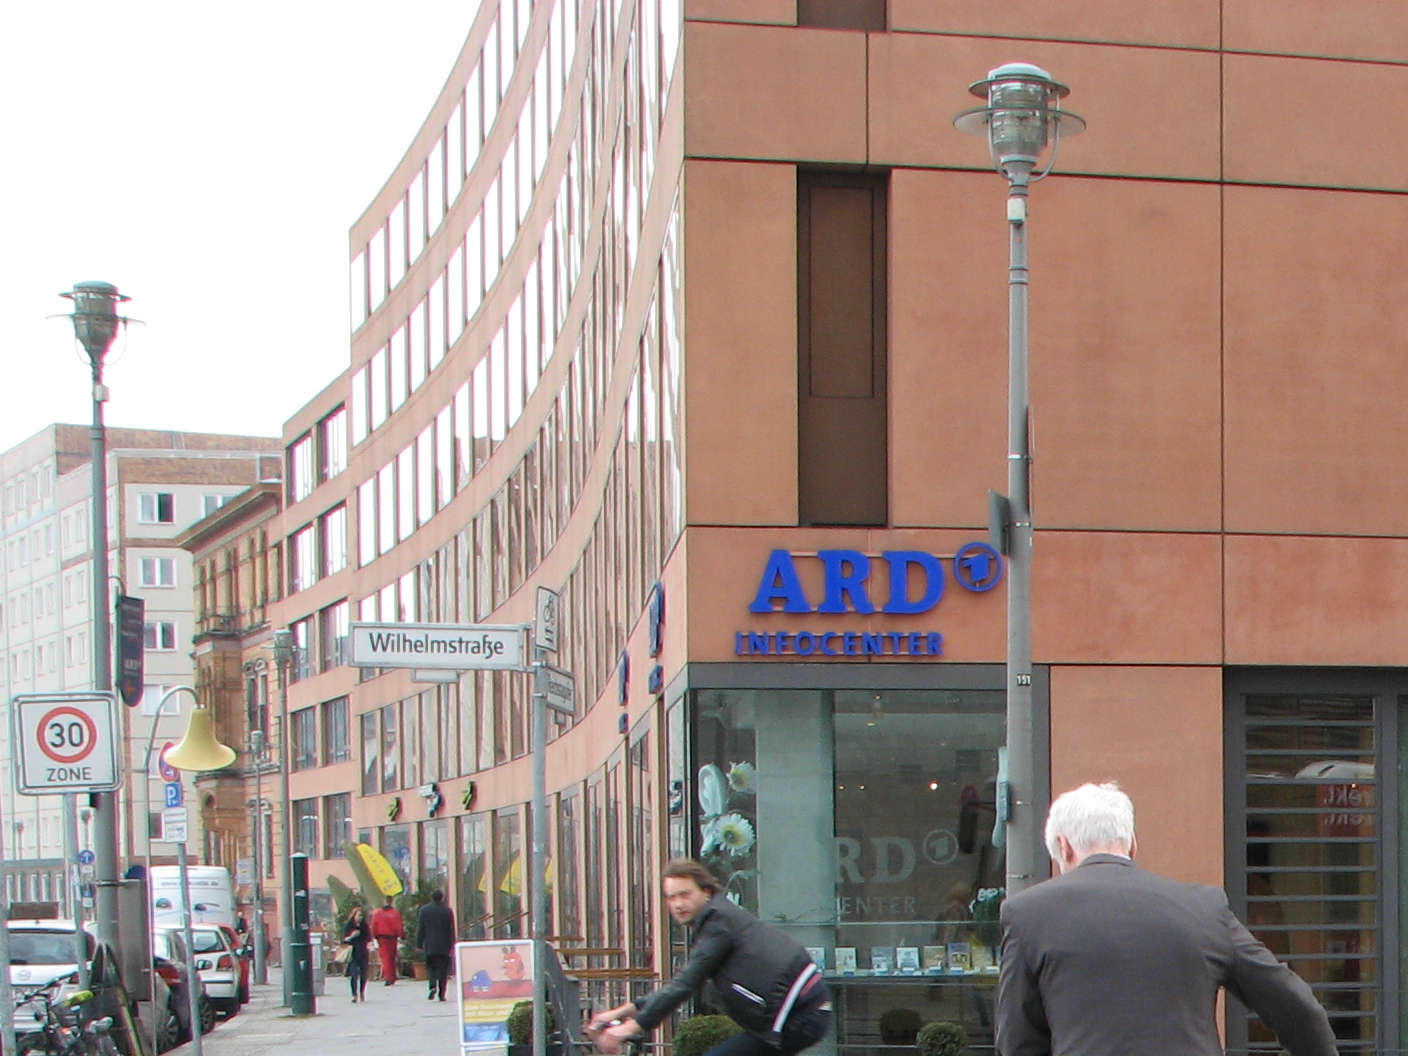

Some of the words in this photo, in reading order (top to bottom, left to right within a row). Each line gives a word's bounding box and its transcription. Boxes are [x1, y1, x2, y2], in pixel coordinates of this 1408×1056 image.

[749, 549, 946, 614] ARD
[369, 631, 504, 659] Wilhelmstraße
[735, 631, 944, 656] INFOCENTER
[49, 722, 84, 748] 30
[46, 767, 94, 782] ZONE
[167, 786, 177, 806] P
